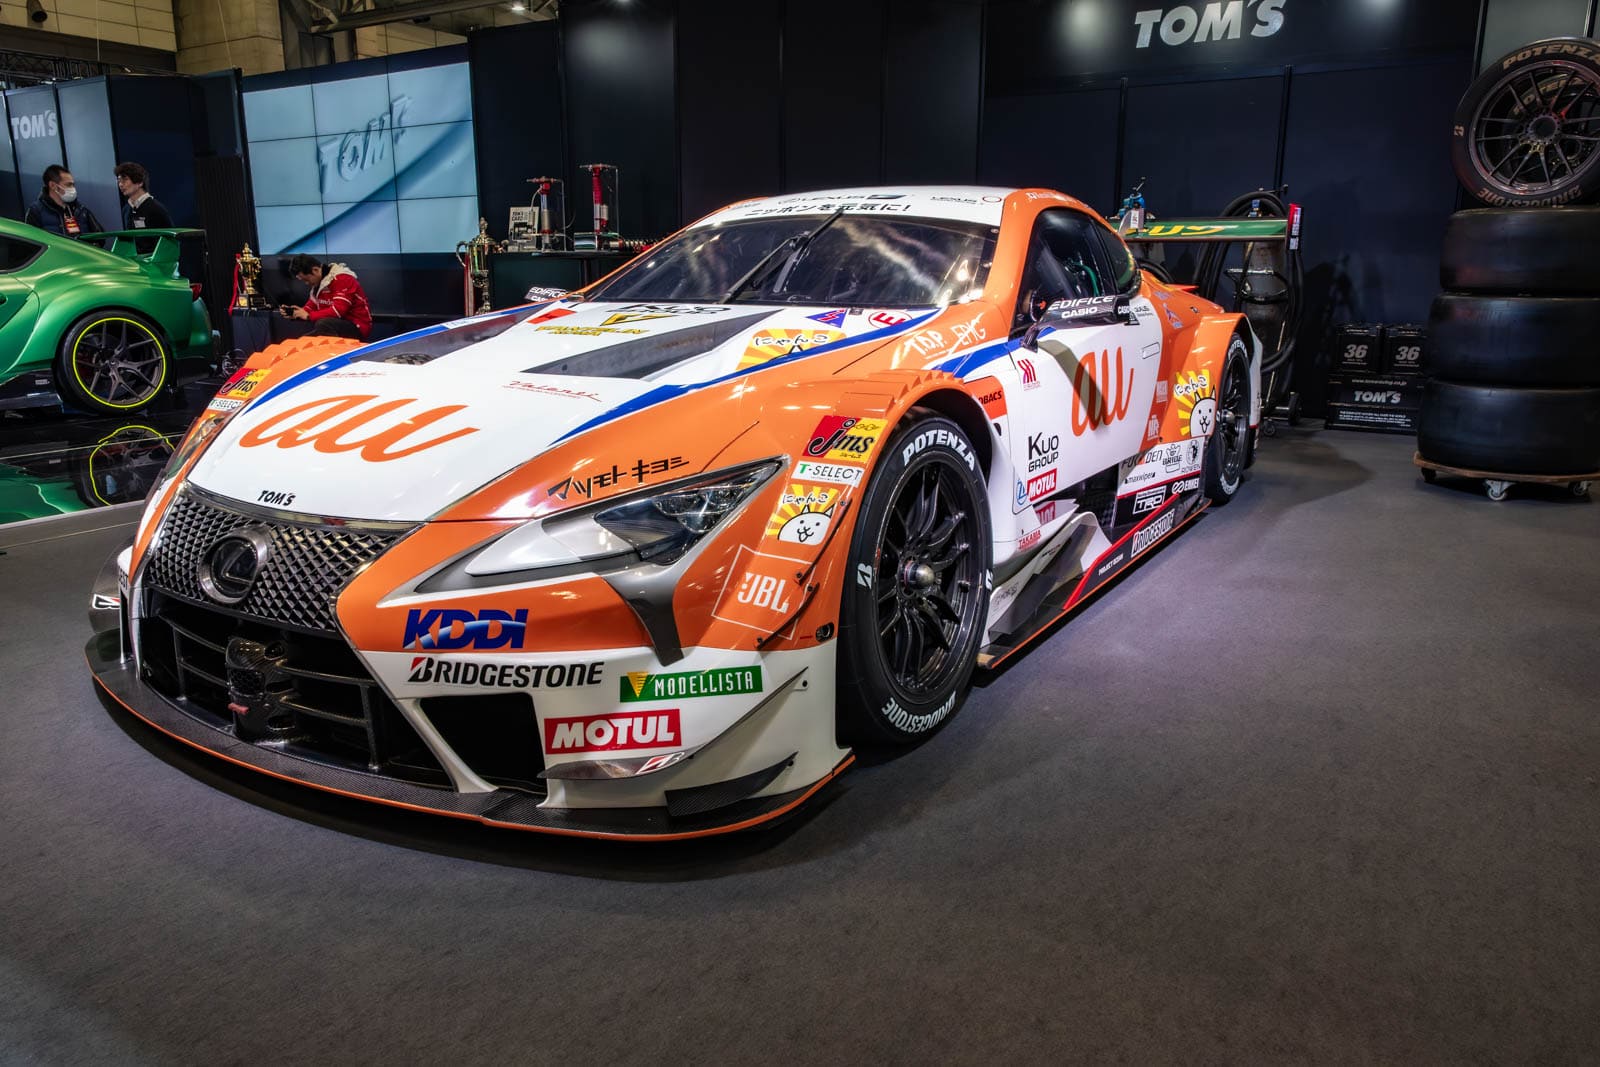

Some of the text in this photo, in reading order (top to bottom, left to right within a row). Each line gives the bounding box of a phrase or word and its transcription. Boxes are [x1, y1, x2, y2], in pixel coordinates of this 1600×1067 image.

[1134, 0, 1286, 48] TOM'S
[11, 109, 57, 139] TOM'S
[1048, 296, 1115, 311] EDIFICE
[1062, 306, 1098, 319] CASIO
[1344, 344, 1368, 359] 36
[1395, 346, 1420, 361] 36
[1071, 346, 1134, 437] au
[1354, 391, 1401, 404] TOM'S
[239, 395, 481, 462] au
[807, 419, 875, 455] jms
[904, 429, 975, 472] POTENZA
[1028, 452, 1059, 473] GROUP
[547, 456, 690, 500] マツモトキヨシ
[799, 463, 862, 481] T-SELECT
[257, 489, 297, 506] TOM'S
[782, 492, 829, 505] にゃんこ
[1030, 477, 1056, 499] MOTUL
[1133, 510, 1176, 556] BRIDGESTONE
[738, 573, 790, 614] JBL
[403, 608, 528, 650] KDDI
[408, 657, 604, 688] BRIDGESTONE
[654, 670, 753, 697] MODELLISTA
[881, 690, 956, 733] BRIDGESTONE
[551, 714, 675, 749] MOTUL
